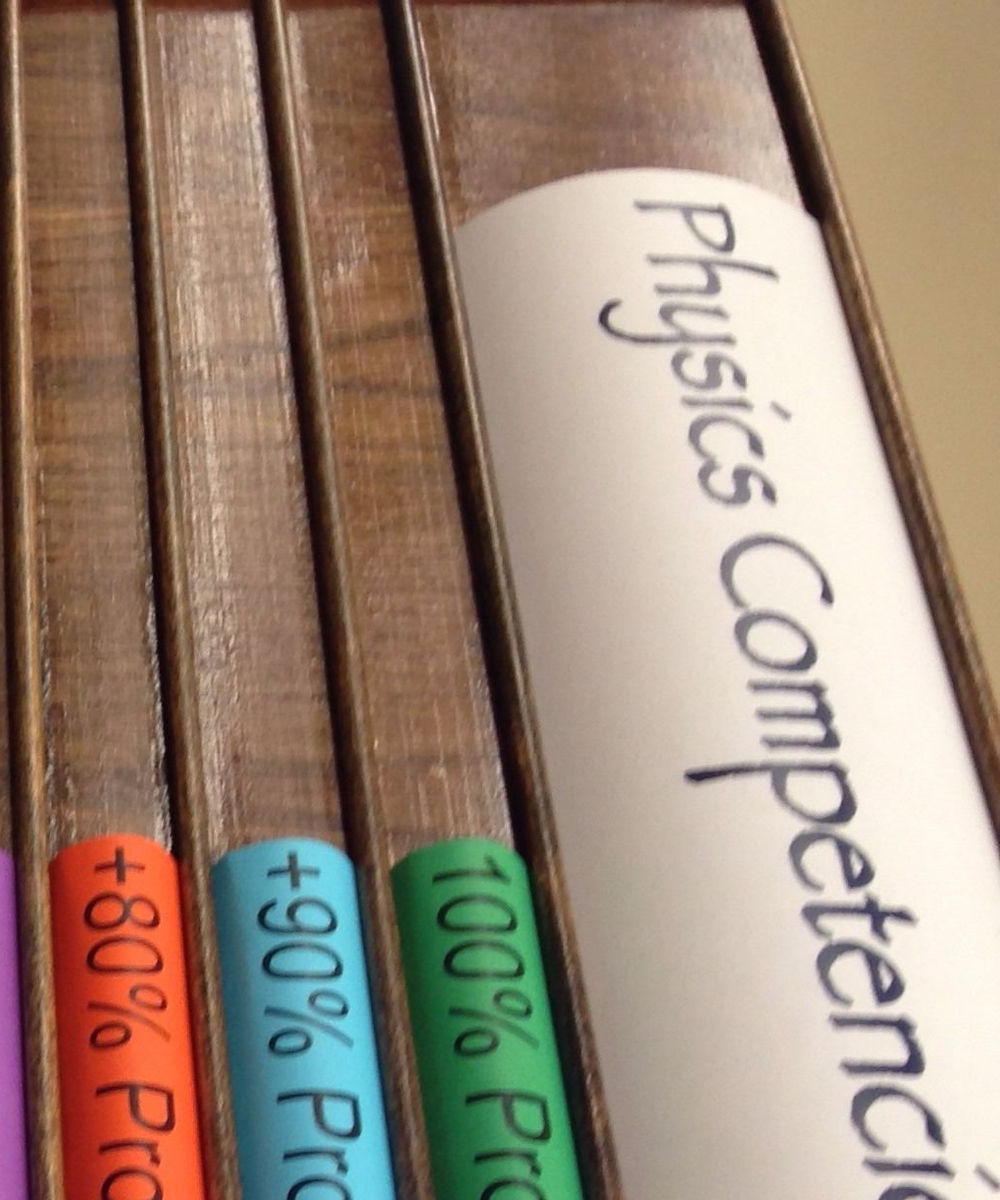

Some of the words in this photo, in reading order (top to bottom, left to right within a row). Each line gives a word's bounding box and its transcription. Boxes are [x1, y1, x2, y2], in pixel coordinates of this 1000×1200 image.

[598, 199, 792, 510] Physics
[84, 847, 172, 1053] +80%
[257, 852, 354, 1059] +90%
[431, 855, 541, 1059] 100%
